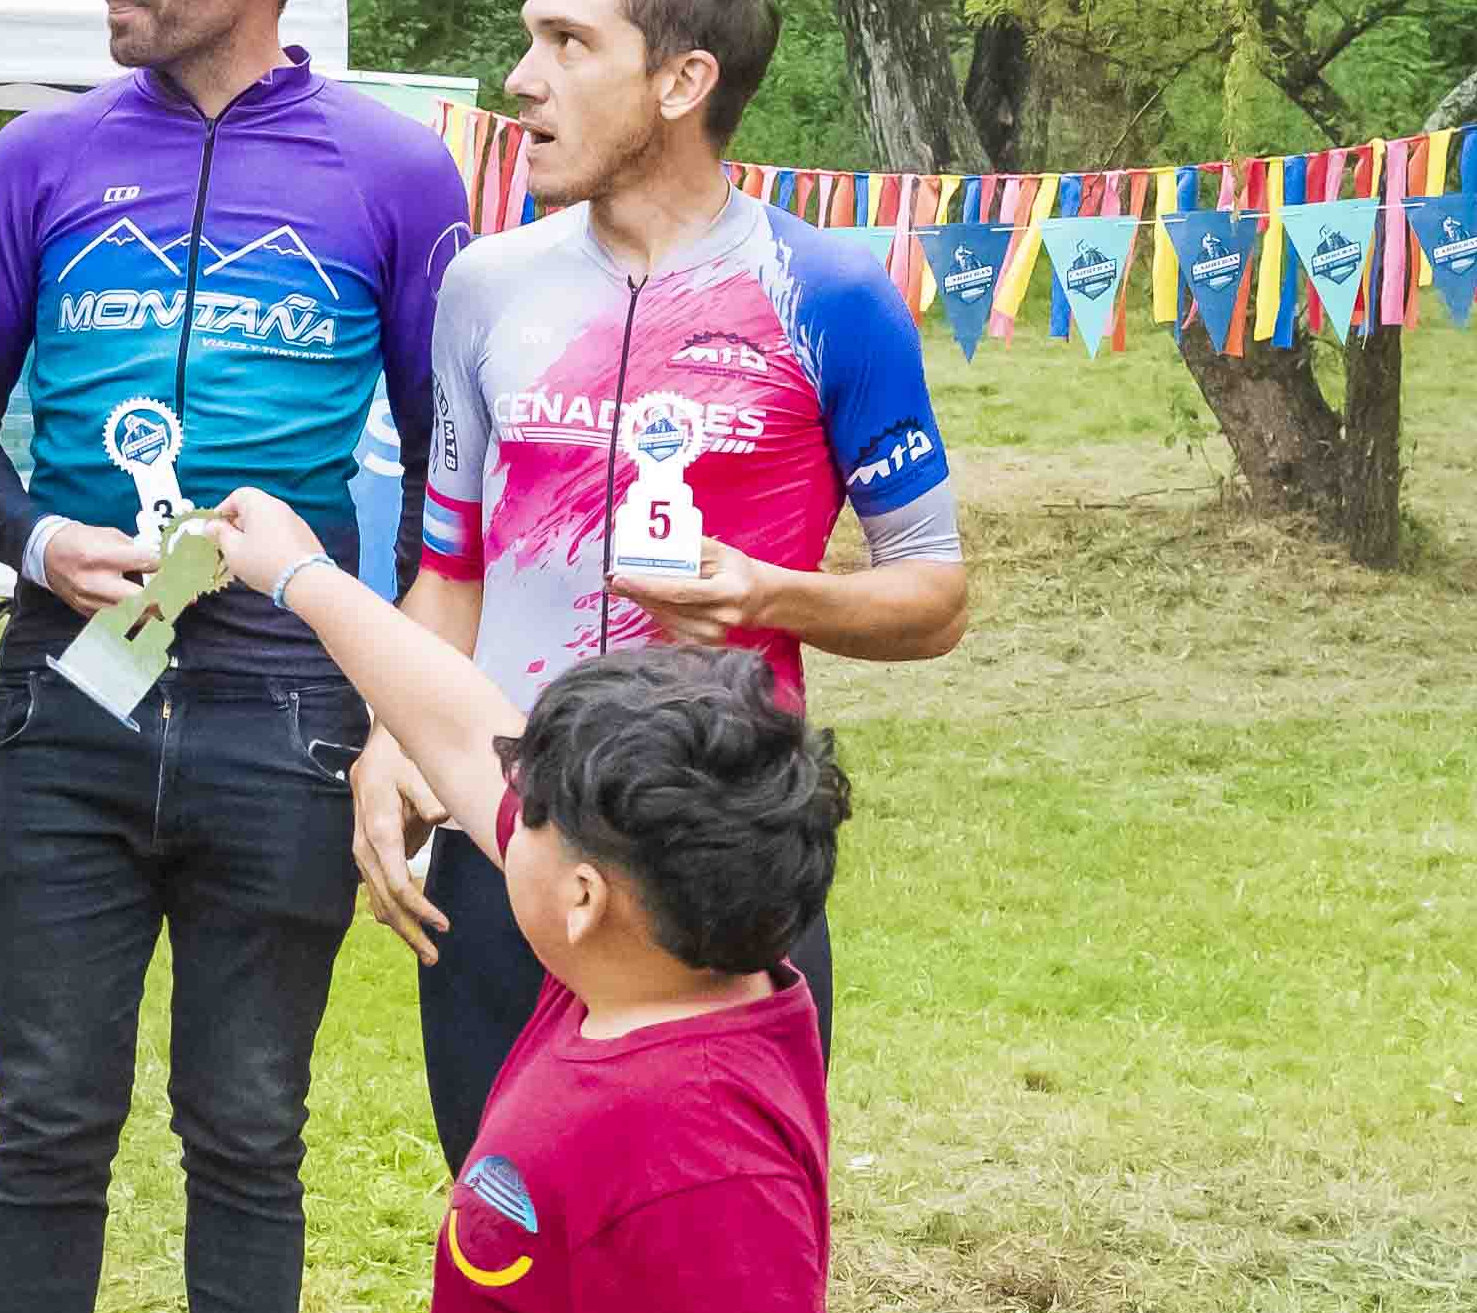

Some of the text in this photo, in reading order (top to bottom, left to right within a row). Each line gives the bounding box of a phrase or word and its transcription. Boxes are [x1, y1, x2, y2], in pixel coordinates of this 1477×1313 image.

[58, 288, 337, 349] MONTAÑA
[445, 420, 458, 471] MTB
[648, 501, 671, 540] 5
